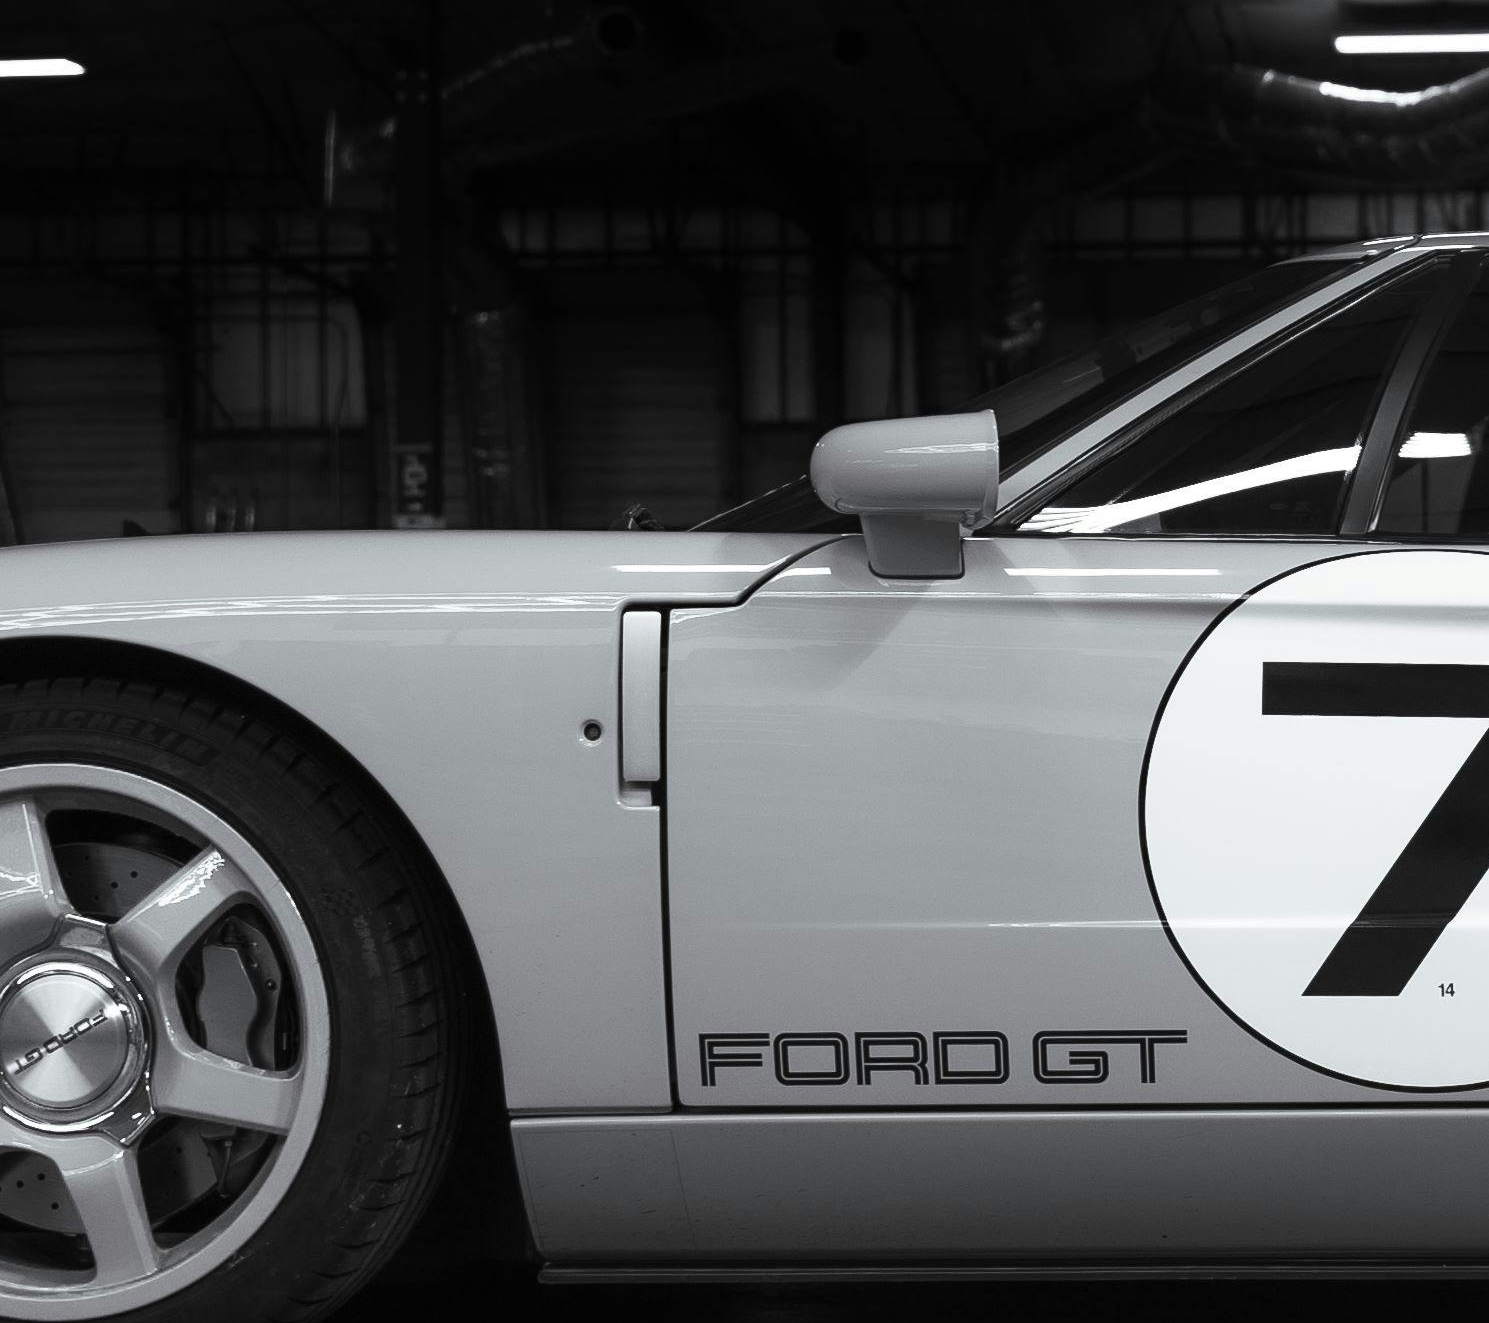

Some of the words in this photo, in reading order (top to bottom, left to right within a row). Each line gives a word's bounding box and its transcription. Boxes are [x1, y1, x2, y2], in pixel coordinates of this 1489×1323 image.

[9, 709, 209, 760] MICHELIN
[1438, 983, 1455, 997] 14
[43, 1009, 109, 1053] FORD
[14, 1048, 43, 1075] GT
[699, 1030, 1010, 1087] FORD
[1034, 1030, 1188, 1084] GT
